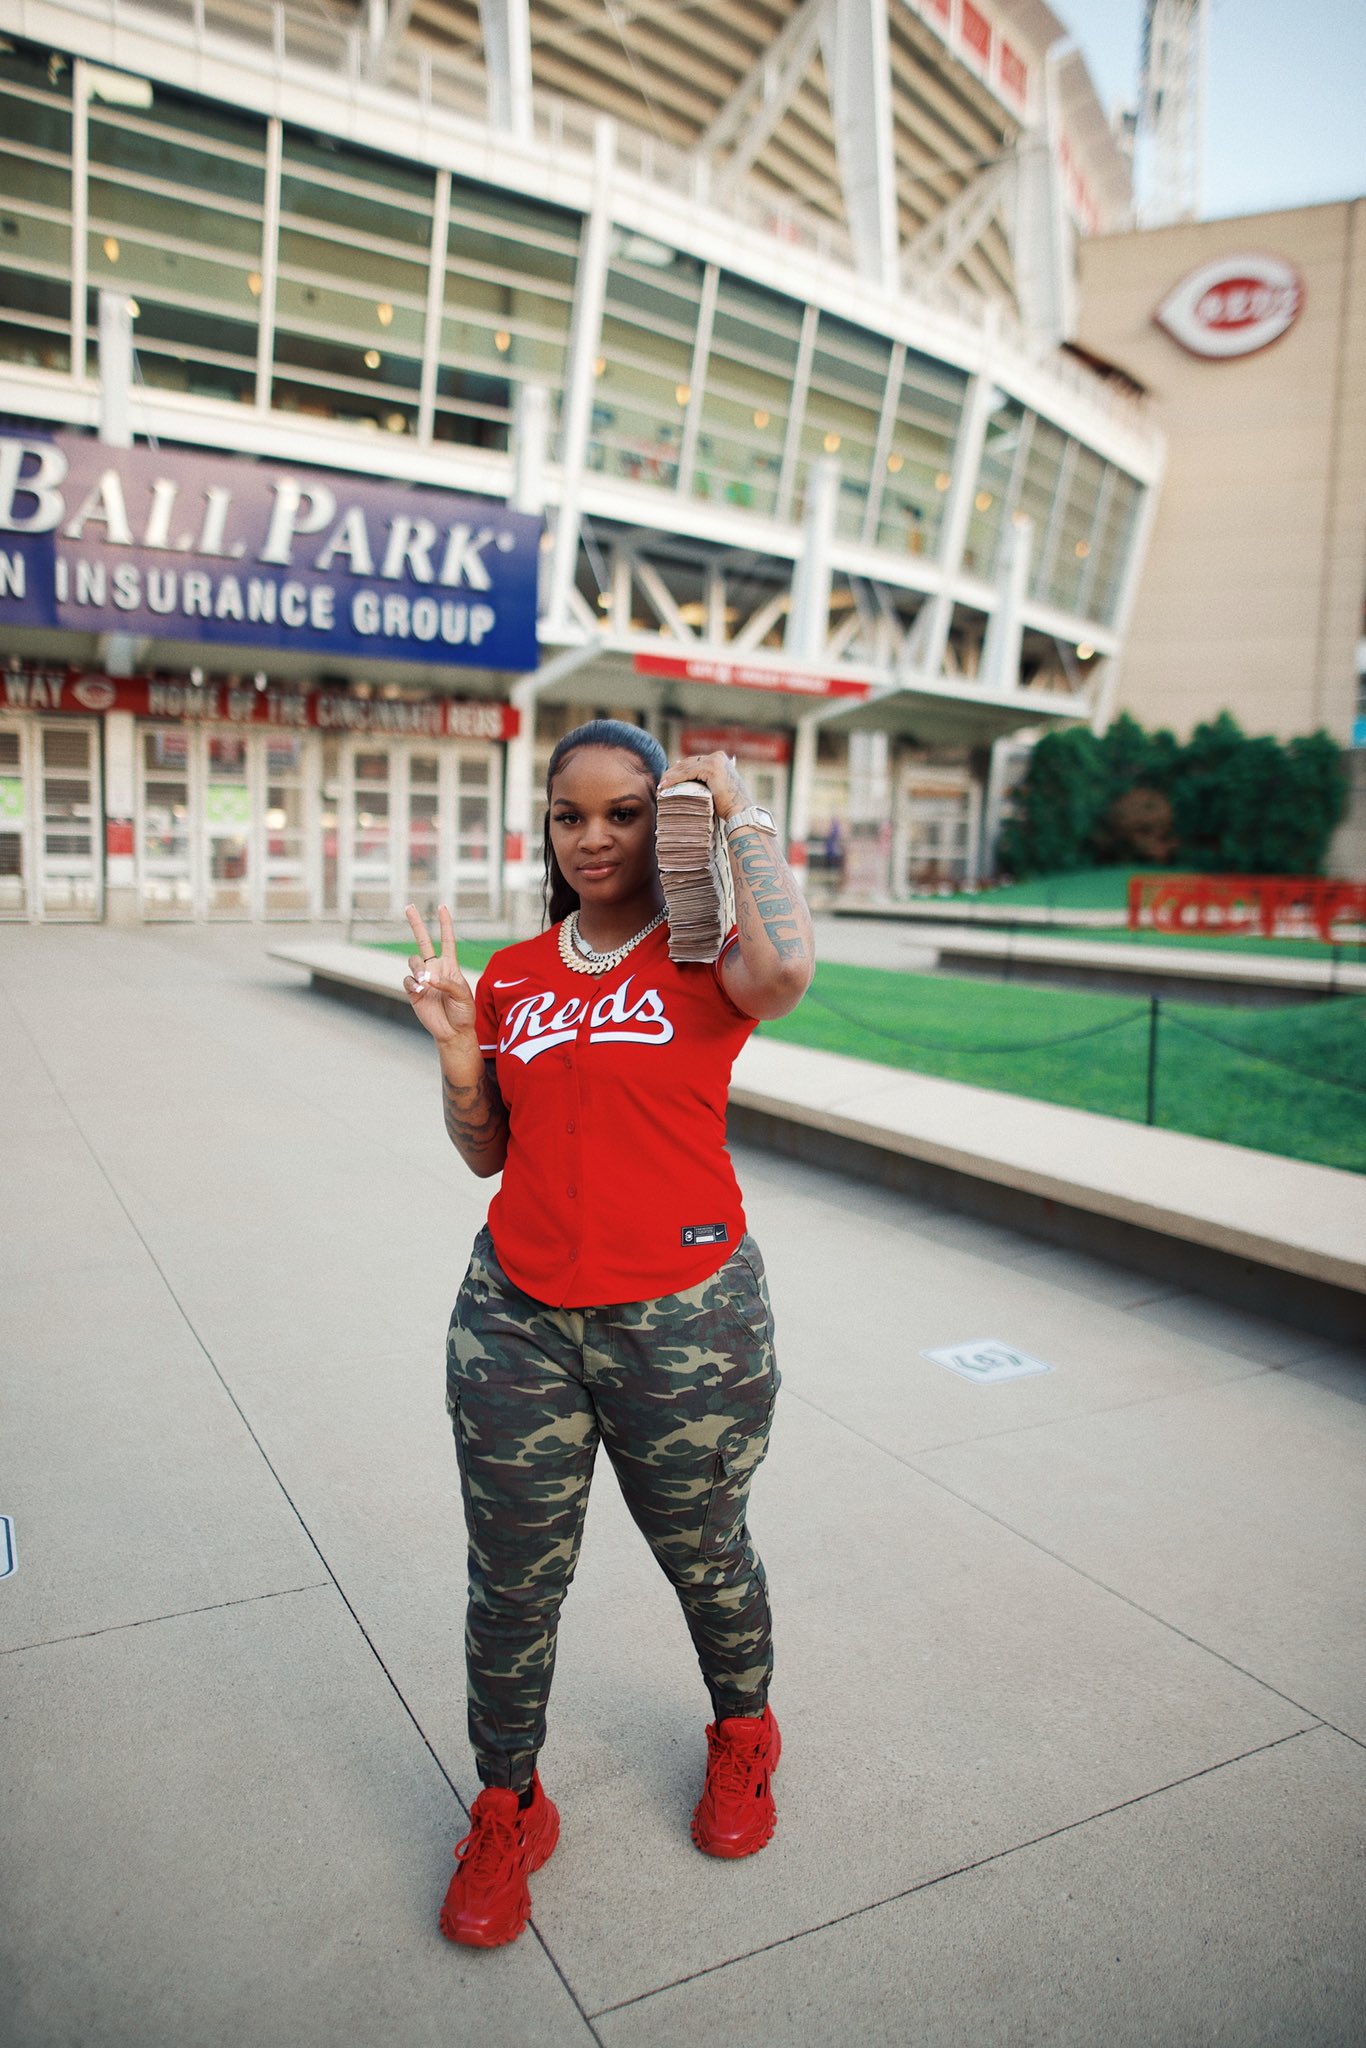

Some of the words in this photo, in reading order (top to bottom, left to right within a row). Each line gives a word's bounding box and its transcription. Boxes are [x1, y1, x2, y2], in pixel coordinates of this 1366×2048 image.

[0, 435, 248, 560] BALL
[257, 476, 493, 592] PARK
[54, 556, 336, 631] INSURANCE
[352, 590, 497, 646] GROUP
[4, 673, 66, 710] WAY
[150, 684, 220, 722] HOME
[267, 692, 309, 729] THE
[729, 832, 805, 961] HUMBLE
[500, 973, 674, 1064] Reds
